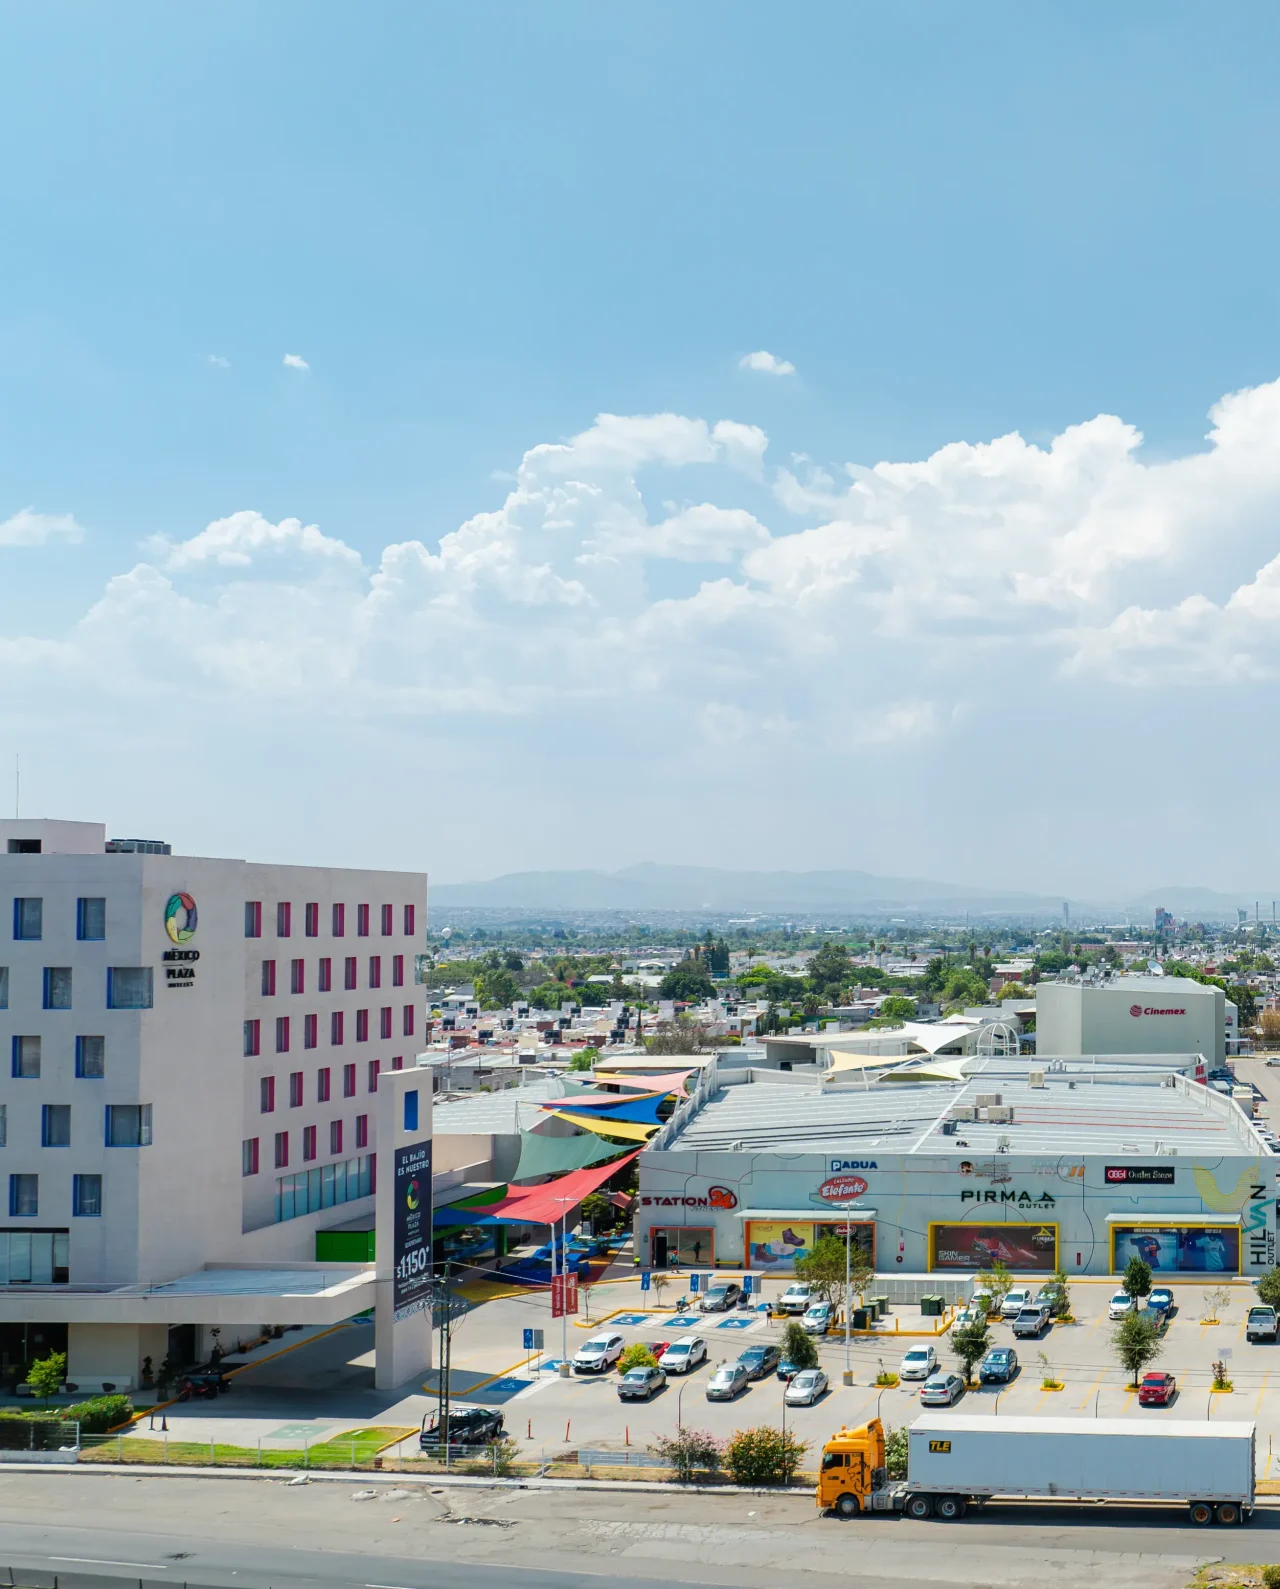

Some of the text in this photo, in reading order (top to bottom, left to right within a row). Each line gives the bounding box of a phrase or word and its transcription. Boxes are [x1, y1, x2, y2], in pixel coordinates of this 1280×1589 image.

[166, 968, 195, 979] PLAZA
[1143, 1007, 1186, 1016] Cinemex
[402, 1156, 409, 1165] EL
[831, 1160, 878, 1172] PADUA
[397, 1159, 430, 1176] ES NUESTRO
[1128, 1170, 1151, 1179] Outlet
[1152, 1170, 1173, 1179] Store
[821, 1182, 866, 1197] Elefante
[641, 1196, 708, 1206] STATION
[961, 1190, 1032, 1203] PIRMA
[1267, 1230, 1275, 1265] OUTLET
[929, 1441, 950, 1452] TLE
